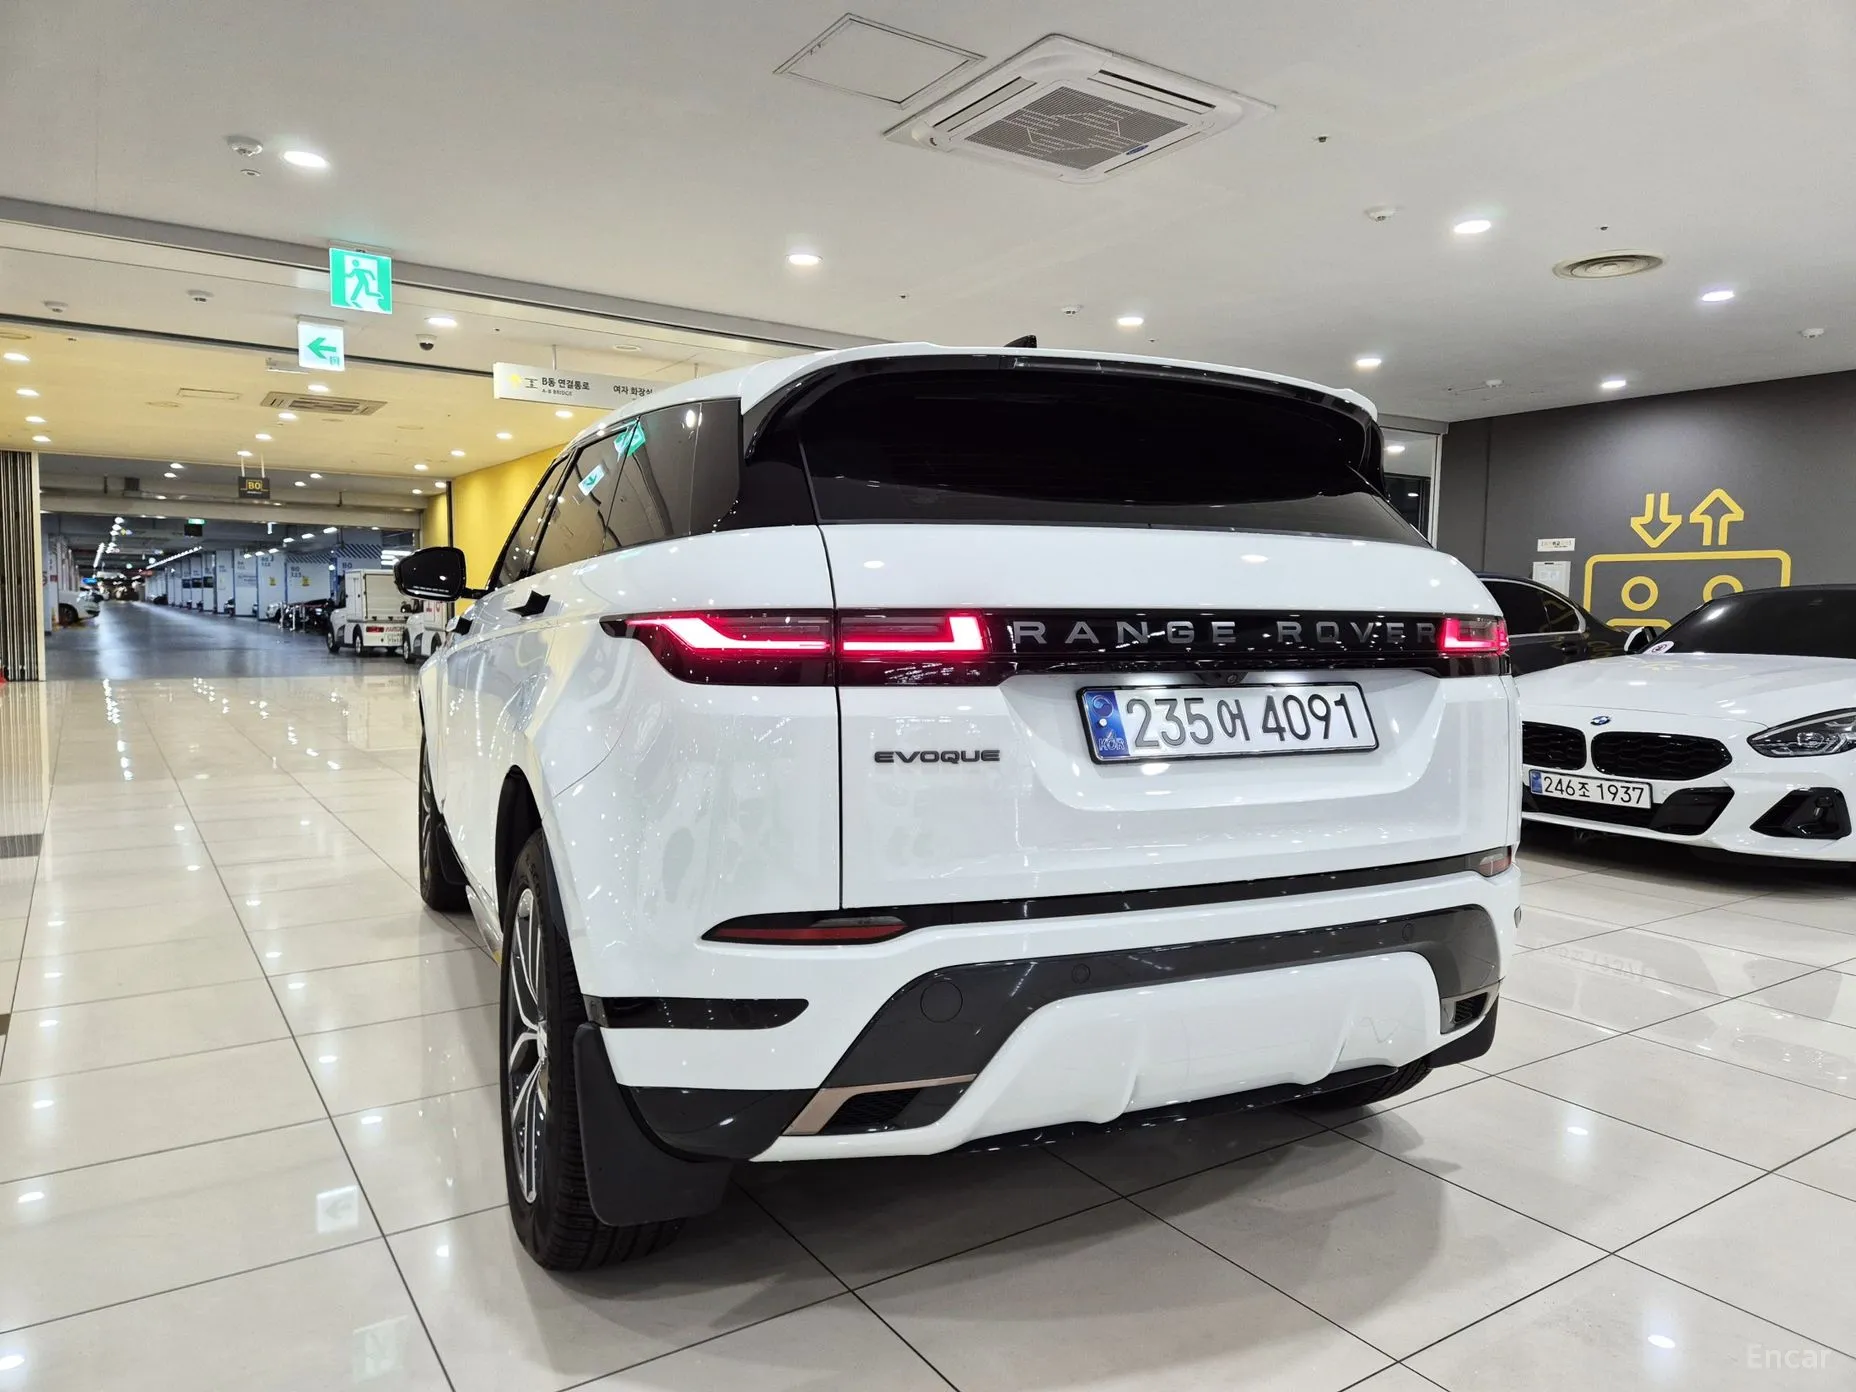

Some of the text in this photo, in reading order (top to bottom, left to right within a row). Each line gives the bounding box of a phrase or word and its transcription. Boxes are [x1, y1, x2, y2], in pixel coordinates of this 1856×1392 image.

[542, 377, 590, 391] B동 연결통로
[613, 385, 629, 395] 여자
[1013, 621, 1436, 644] RANGE ROVER
[1126, 693, 1358, 748] 235어 4091
[874, 749, 1001, 764] EVOQUE
[1543, 776, 1644, 804] 246조 1937
